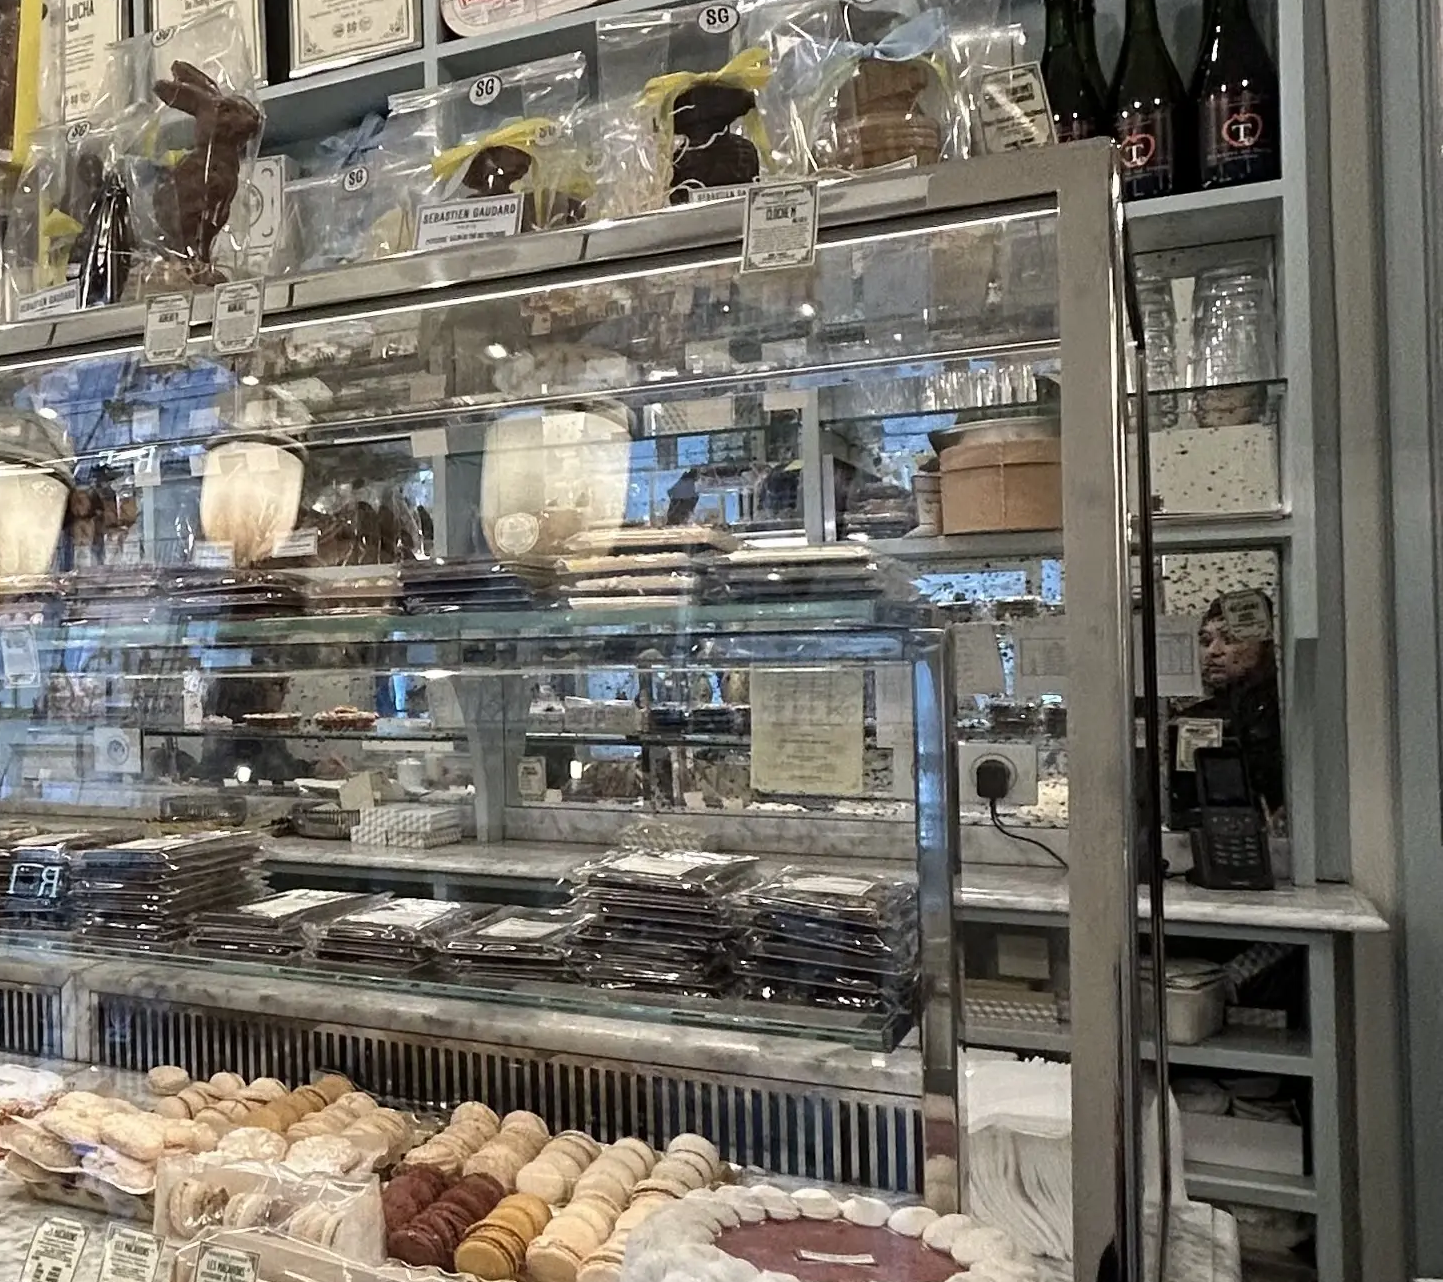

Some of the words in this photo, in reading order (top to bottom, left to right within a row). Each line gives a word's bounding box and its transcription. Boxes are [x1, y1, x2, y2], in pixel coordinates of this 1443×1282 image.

[706, 7, 730, 25] SG
[476, 78, 495, 98] SG
[348, 168, 363, 186] SG
[423, 207, 470, 225] SEBASTIEN
[472, 203, 517, 219] GAUDARD
